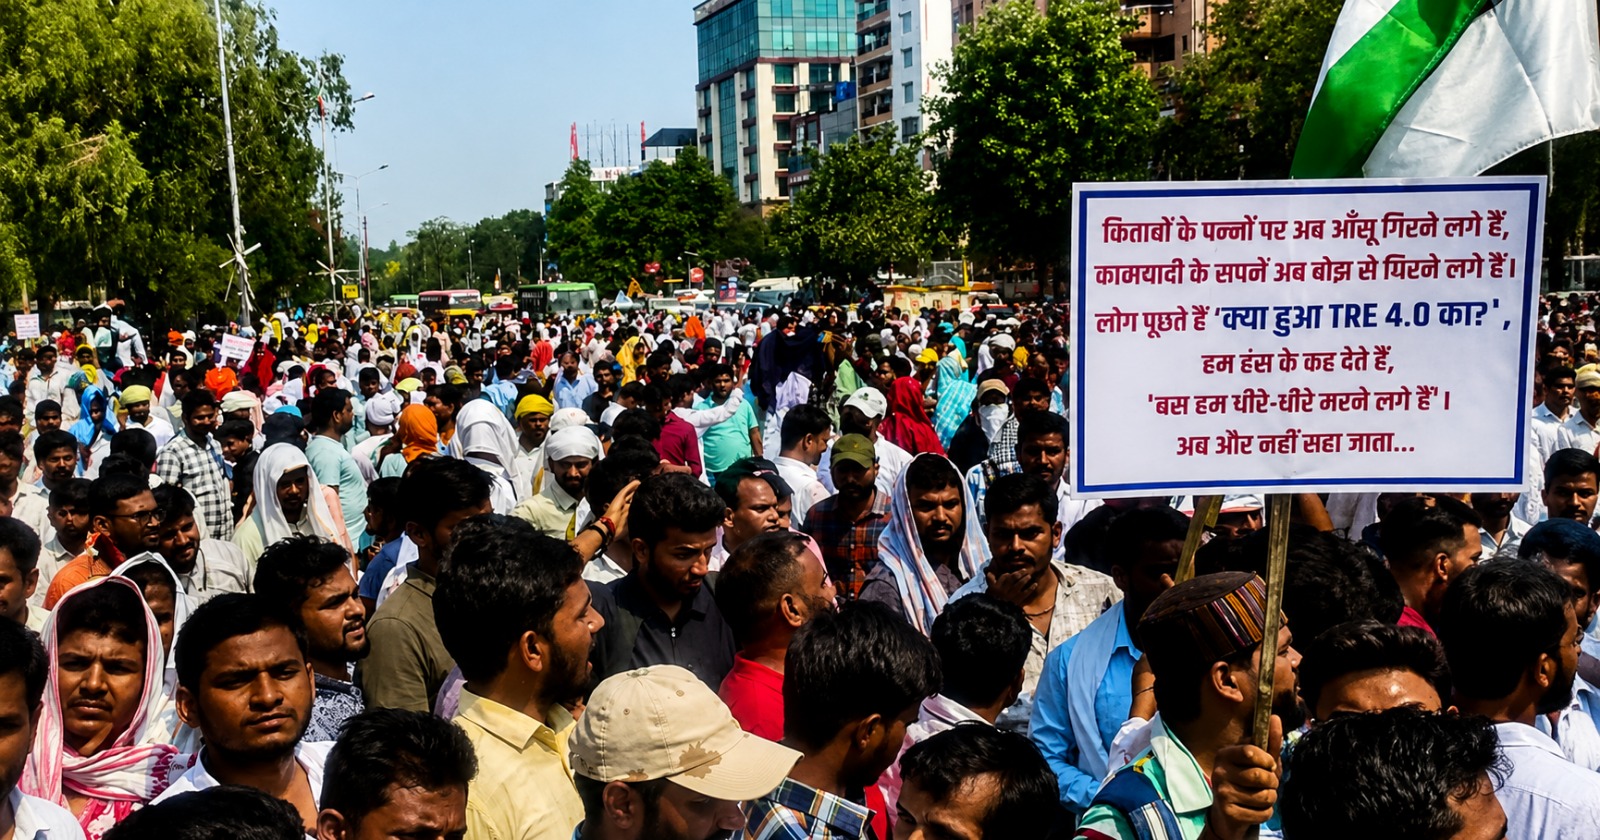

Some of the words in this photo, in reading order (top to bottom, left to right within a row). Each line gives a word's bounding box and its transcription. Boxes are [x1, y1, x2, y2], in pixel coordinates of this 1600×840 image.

[1102, 215, 1176, 244] किताबों
[1176, 215, 1198, 243] के
[1202, 214, 1258, 242] पन्नों
[1259, 219, 1289, 241] पर
[1293, 219, 1327, 240] अब
[1331, 209, 1380, 247] आँसू
[1381, 210, 1440, 239] गिरने
[1443, 209, 1484, 238] लगे
[1486, 209, 1510, 241] हैं,
[1189, 257, 1211, 284] के
[1214, 256, 1271, 284] सपनें
[1274, 261, 1308, 283] अब
[1310, 255, 1354, 284] बोझ
[1356, 253, 1380, 281] से
[1444, 251, 1486, 279] लगे
[1094, 306, 1139, 333] लोग
[1142, 305, 1188, 339] पूछते
[1191, 304, 1210, 332] हैं
[1272, 304, 1324, 338] हुआ
[1328, 302, 1378, 329] TRE
[1384, 302, 1431, 328] 4.0
[1200, 354, 1236, 375] हम
[1239, 348, 1275, 374] हंस
[1277, 347, 1300, 373] के
[1302, 352, 1338, 372] कह
[1339, 345, 1371, 372] देते
[1372, 344, 1394, 374] हैं,
[1193, 395, 1229, 415] हम
[1318, 385, 1371, 412] मरने
[1373, 385, 1413, 411] लगे
[1176, 436, 1211, 456] अब
[1215, 429, 1255, 455] और
[1256, 428, 1302, 455] नहीं
[1301, 433, 1344, 454] सहा
